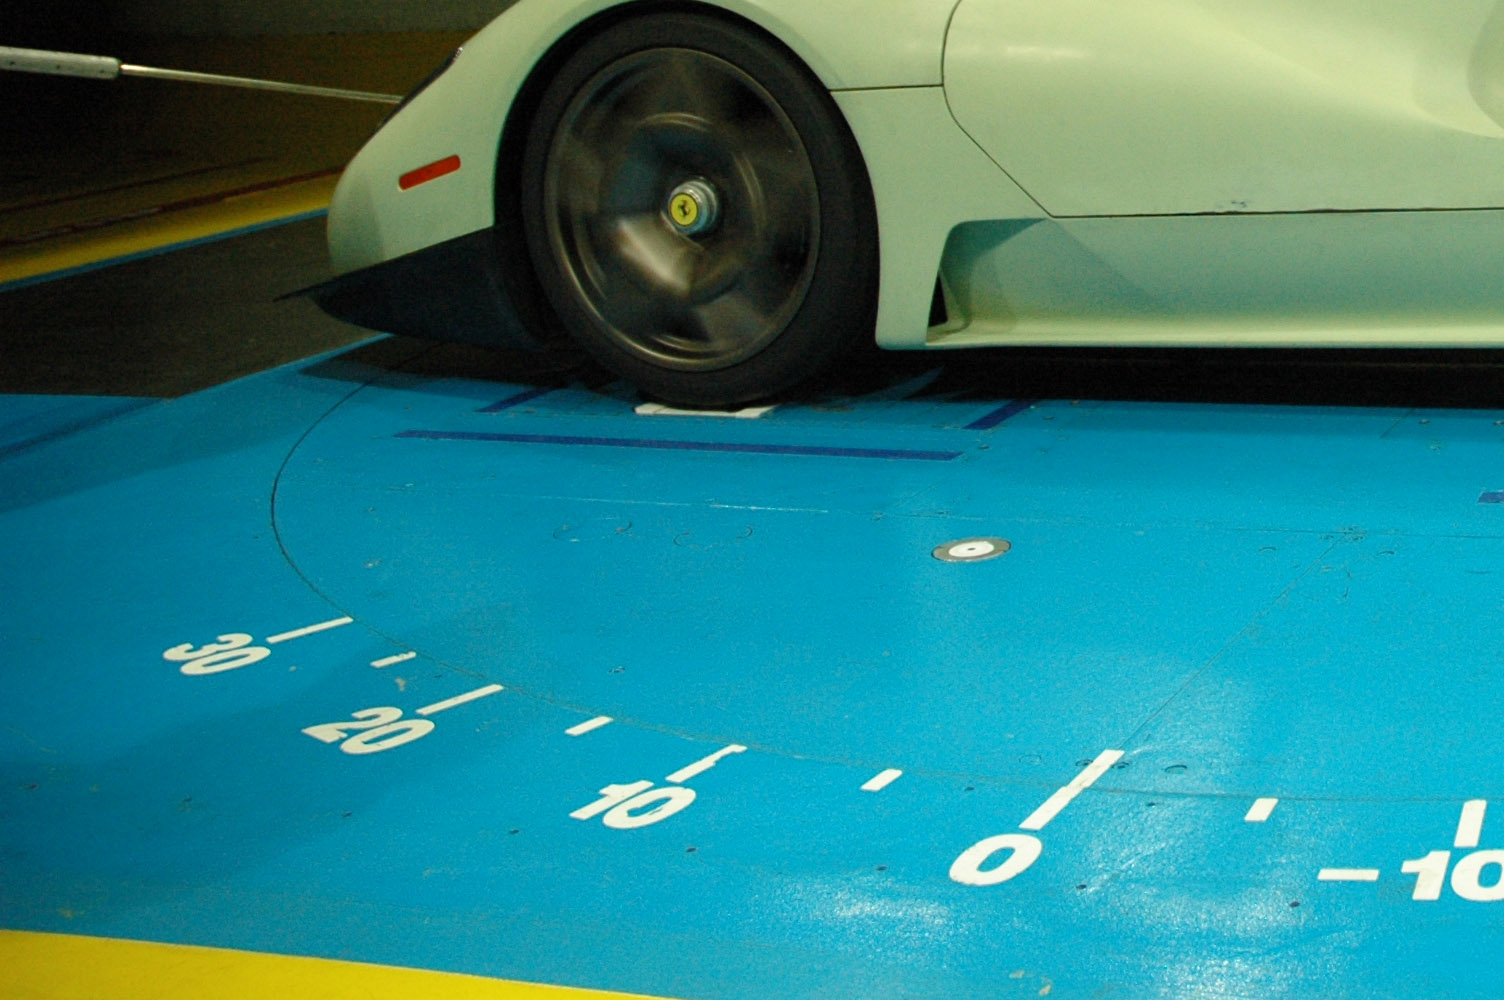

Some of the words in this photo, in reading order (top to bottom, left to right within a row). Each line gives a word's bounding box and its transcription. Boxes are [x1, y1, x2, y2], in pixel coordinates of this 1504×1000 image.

[163, 633, 271, 675] 30
[302, 707, 435, 755] 20
[570, 780, 697, 830] 10
[949, 833, 1043, 887] 0
